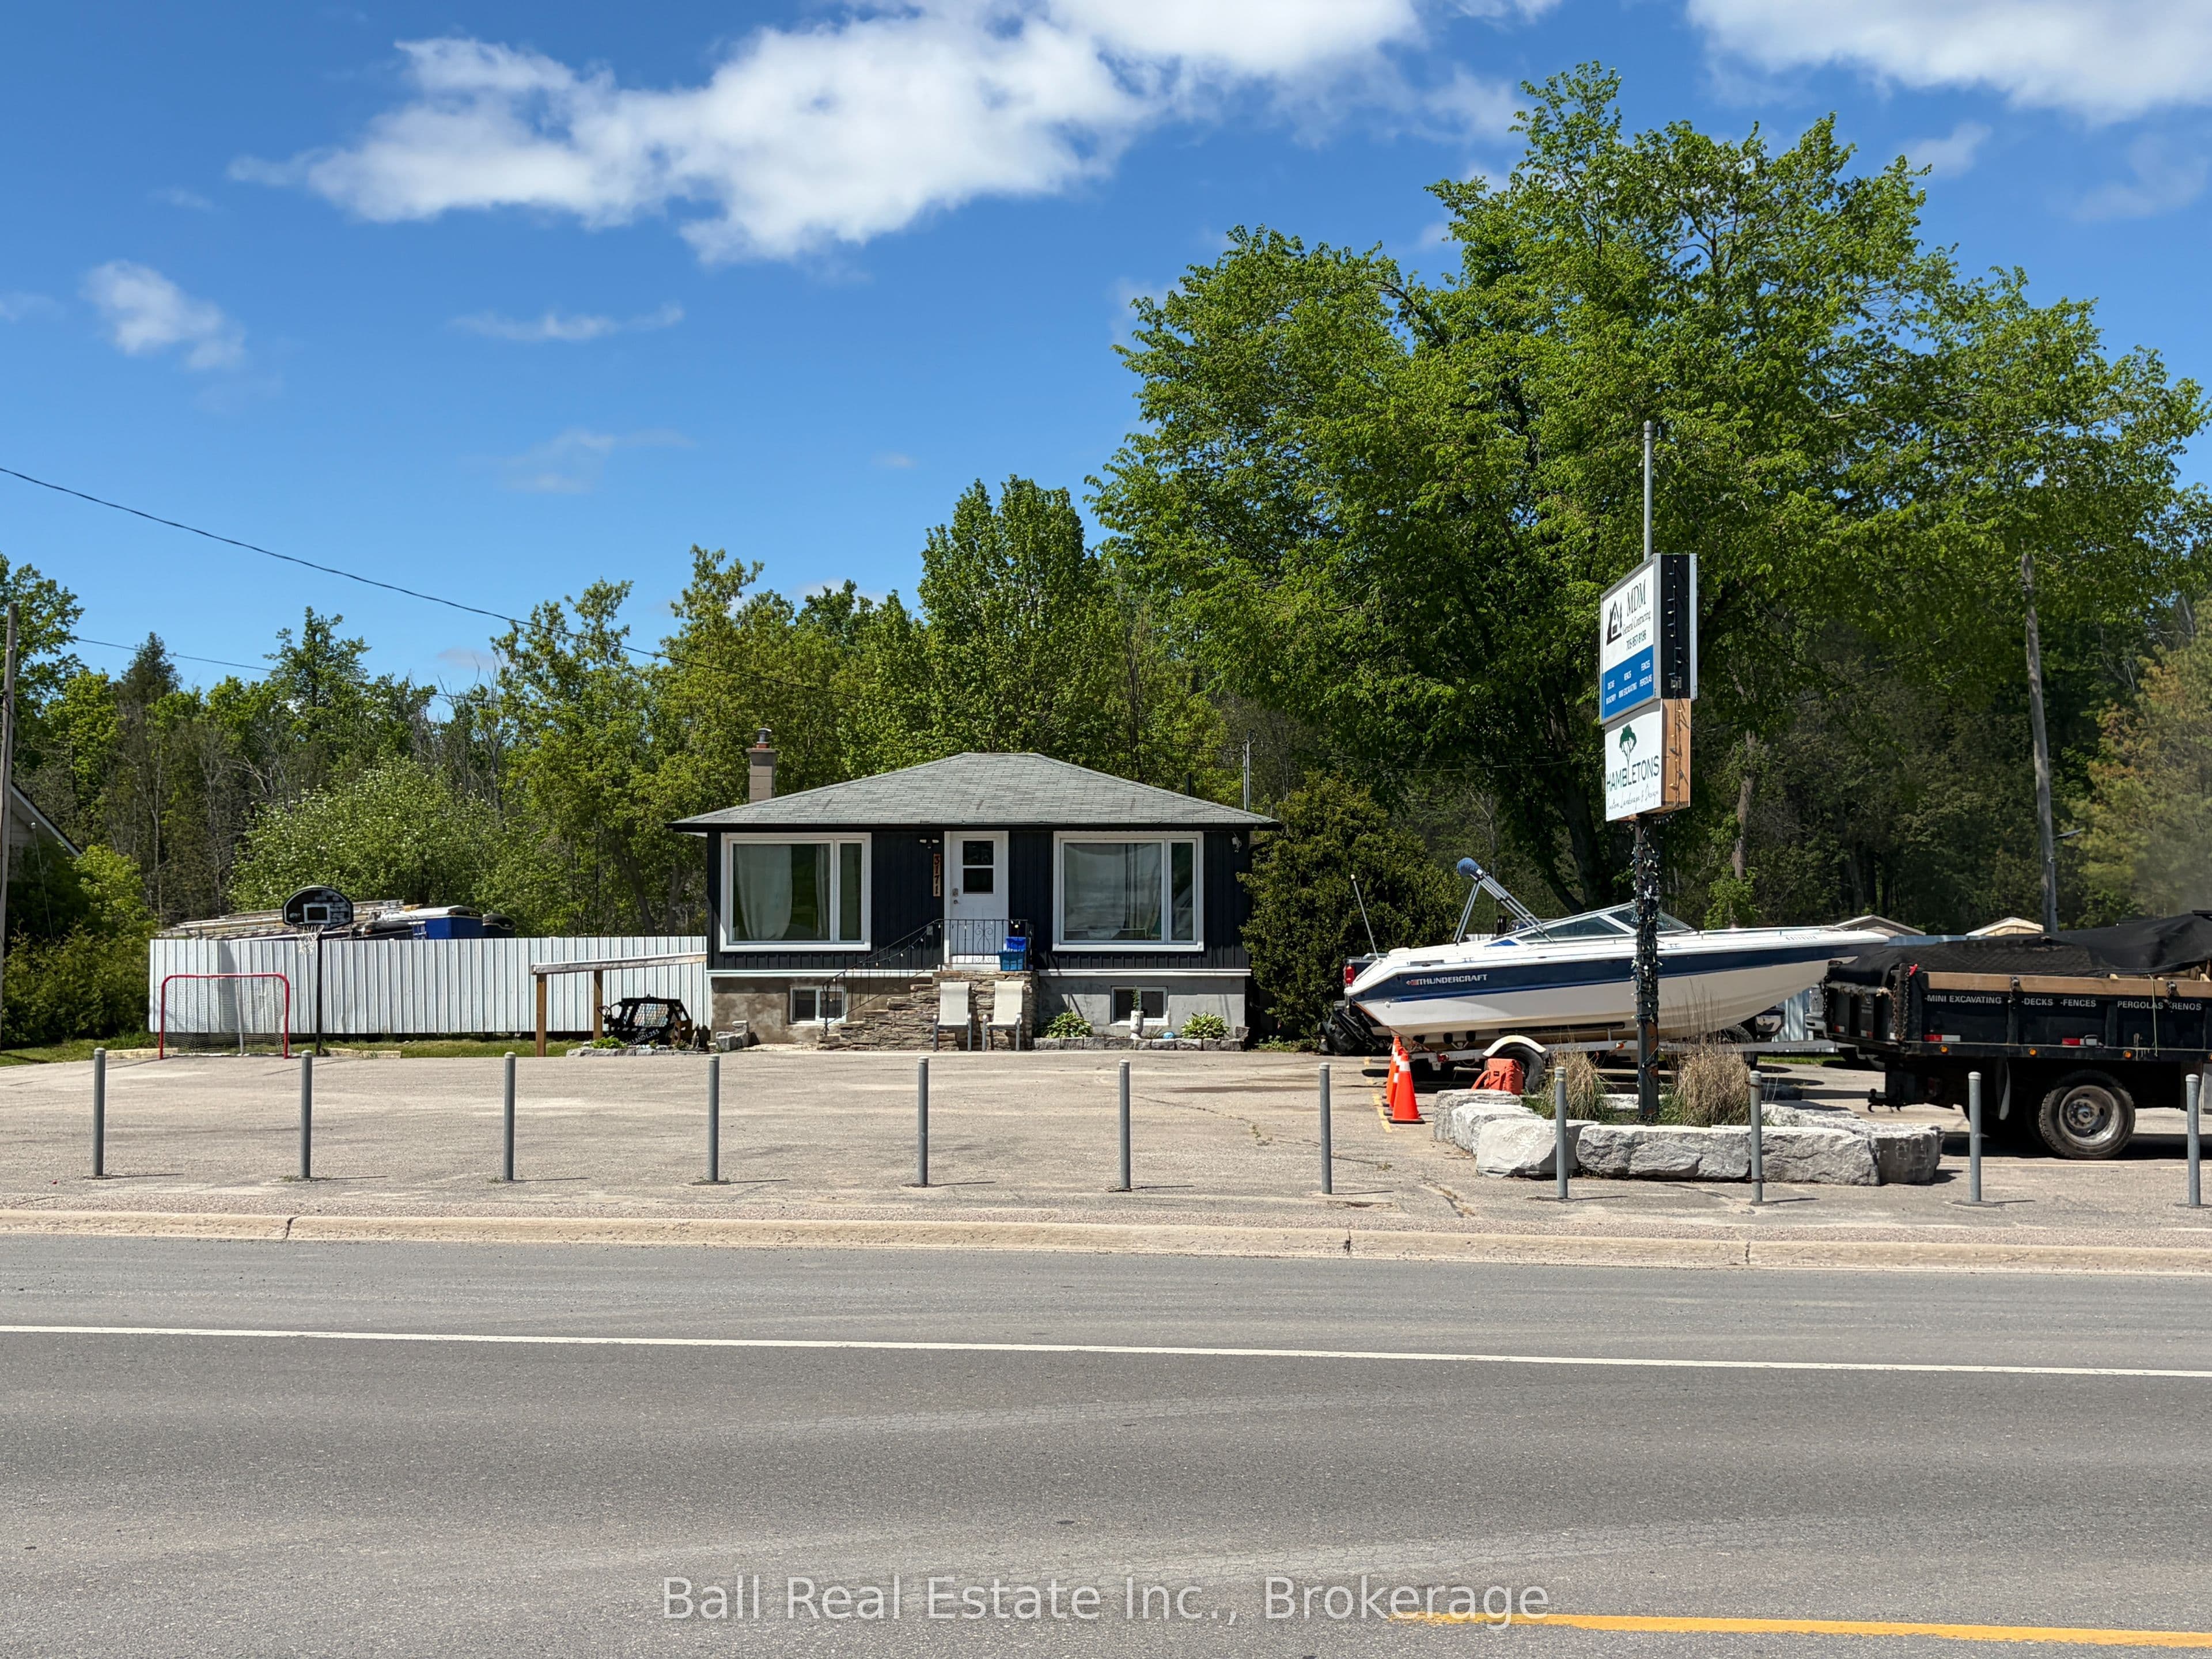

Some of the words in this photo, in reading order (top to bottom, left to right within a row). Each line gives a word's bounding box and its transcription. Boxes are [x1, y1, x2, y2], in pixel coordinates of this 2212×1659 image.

[1626, 579, 1646, 617] MDM
[1607, 755, 1660, 793] HAMBLETONS
[1418, 974, 1487, 985] THUNDERCRAFT
[1949, 995, 2002, 1004] EXCAVATING
[2117, 1001, 2164, 1009] PERGOLAS
